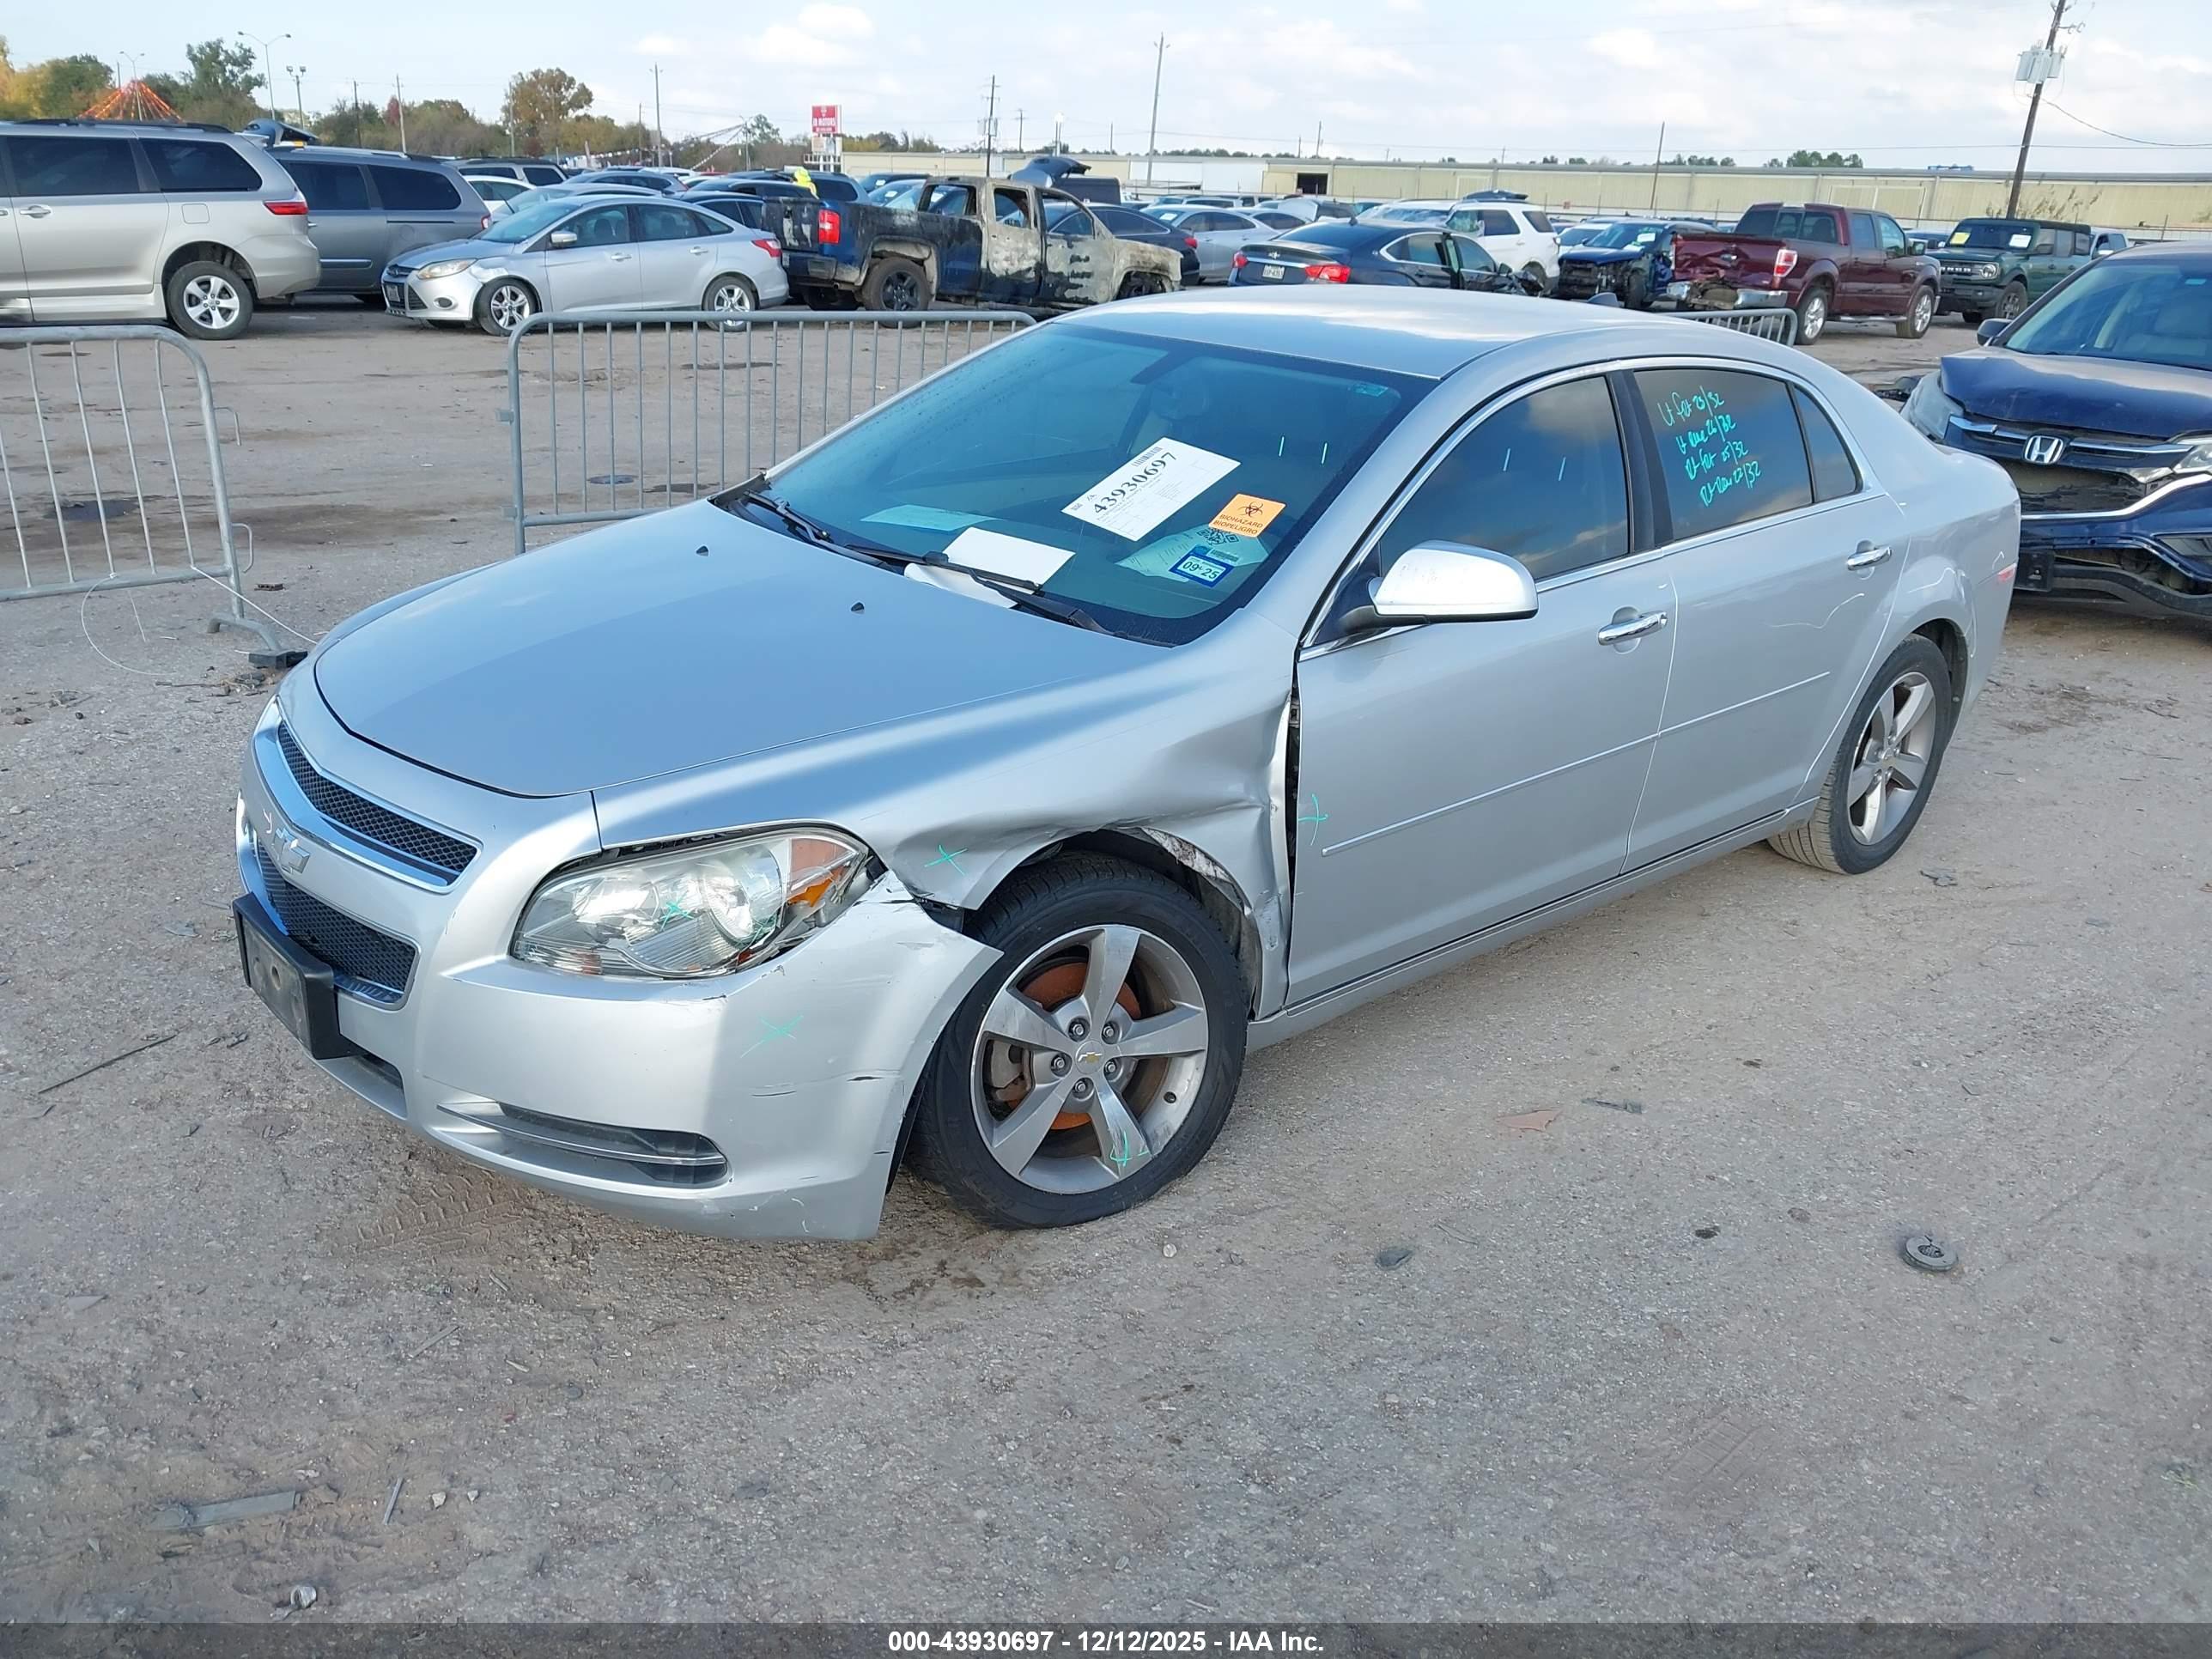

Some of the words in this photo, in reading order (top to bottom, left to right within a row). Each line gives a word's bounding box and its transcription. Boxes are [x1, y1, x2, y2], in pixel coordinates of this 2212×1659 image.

[1093, 452, 1177, 514] 43930697
[1212, 520, 1258, 535] BIOPELIGRO
[1218, 514, 1264, 529] BIOHAZARD
[1182, 561, 1200, 572] 09
[1202, 567, 1220, 580] 25
